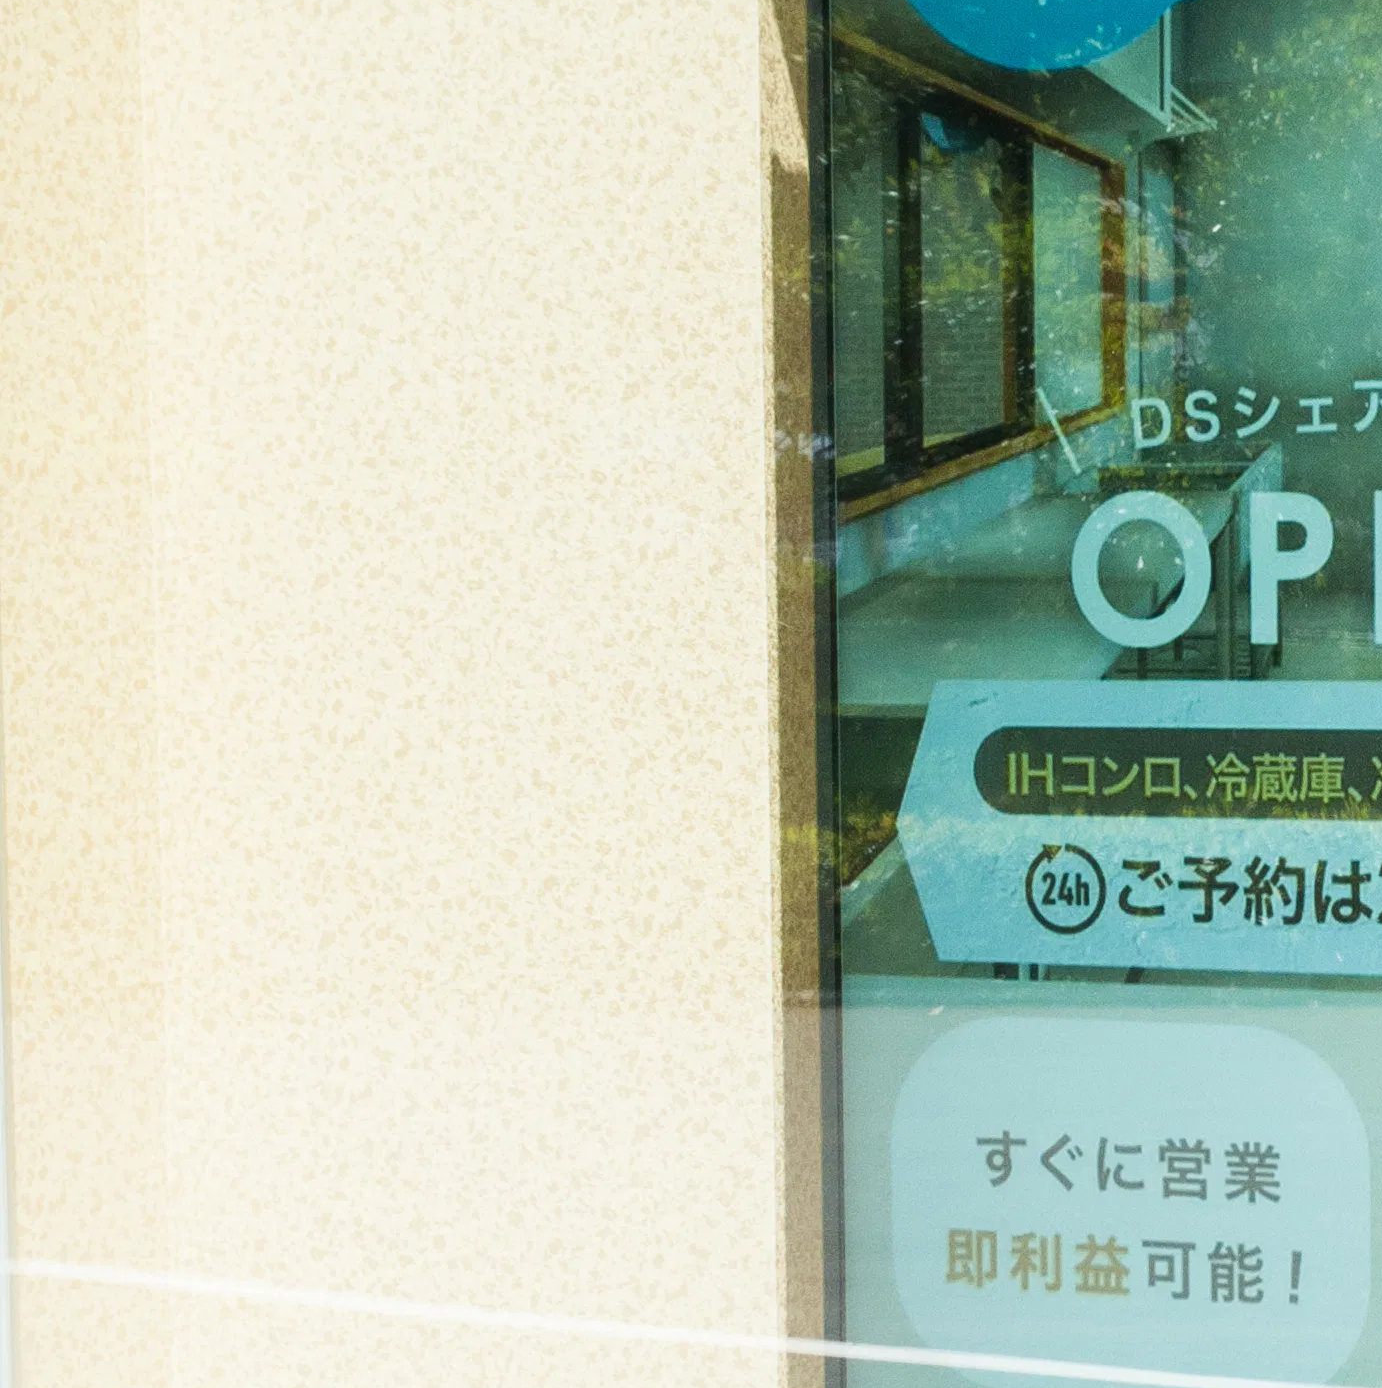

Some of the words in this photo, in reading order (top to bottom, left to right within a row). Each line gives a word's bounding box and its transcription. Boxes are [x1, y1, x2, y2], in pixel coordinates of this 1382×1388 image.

[1041, 872, 1090, 907] 24h
[976, 1130, 1282, 1204] すぐに営業
